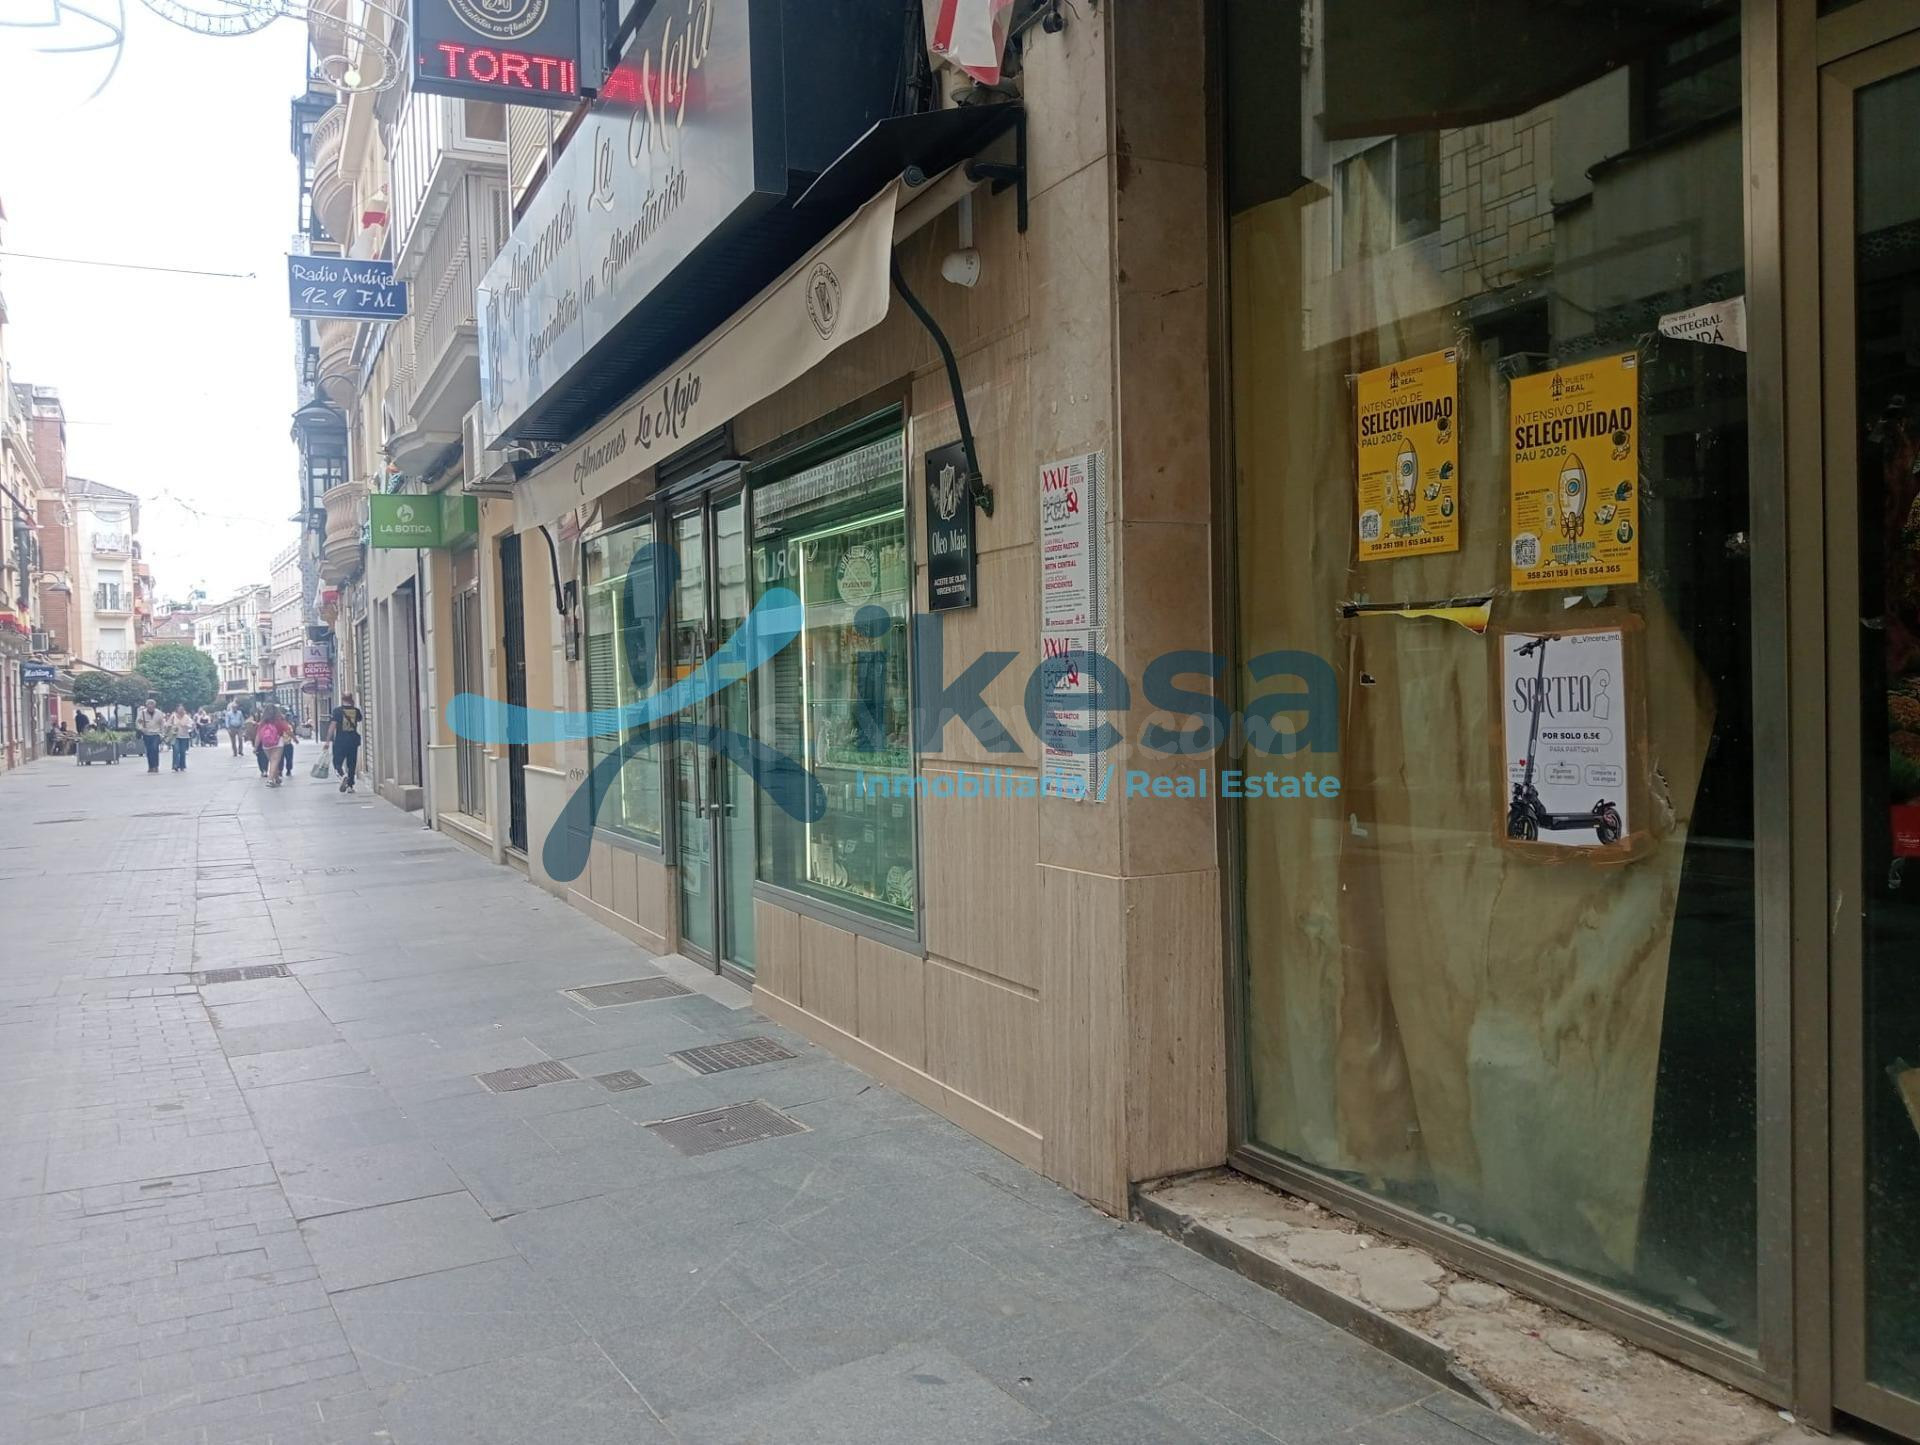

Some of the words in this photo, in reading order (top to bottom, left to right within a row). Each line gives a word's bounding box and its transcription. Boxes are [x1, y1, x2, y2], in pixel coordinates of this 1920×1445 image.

[504, 190, 576, 341] Almacenes
[588, 126, 614, 212] La
[602, 166, 687, 295] Alimentación
[292, 264, 338, 282] Radio
[356, 289, 396, 307] FM
[1671, 314, 1723, 335] INTEGRAL
[1566, 373, 1594, 384] PUERTA
[1566, 384, 1584, 392] REAL
[1361, 395, 1407, 414] INTENSIVO
[1410, 392, 1422, 401] DE
[1515, 404, 1574, 424] INTENSIVO
[1578, 400, 1592, 412] DE
[1362, 396, 1453, 437] SELECTIVIDAD
[574, 428, 626, 495] Almacenes
[635, 406, 651, 449] La
[655, 372, 701, 439] Maja
[1515, 406, 1632, 450] SELECTIVIDAD
[1362, 436, 1378, 448] PAU
[1516, 450, 1536, 463] PAU
[1540, 445, 1567, 460] 2026
[1043, 466, 1069, 492] XXVI
[380, 524, 392, 533] LA
[394, 525, 432, 534] BOTICA
[932, 531, 948, 556] Oleo
[950, 528, 967, 558] Maja
[1606, 564, 1620, 572] 365
[934, 577, 948, 586] ACEITE
[949, 576, 954, 584] DE
[952, 584, 966, 594] EXTRA
[1043, 638, 1070, 659] XXVI
[1512, 675, 1591, 718] SORTEO
[1542, 732, 1558, 740] POR
[1560, 732, 1581, 740] SOLO
[1584, 732, 1600, 740] 6.5€
